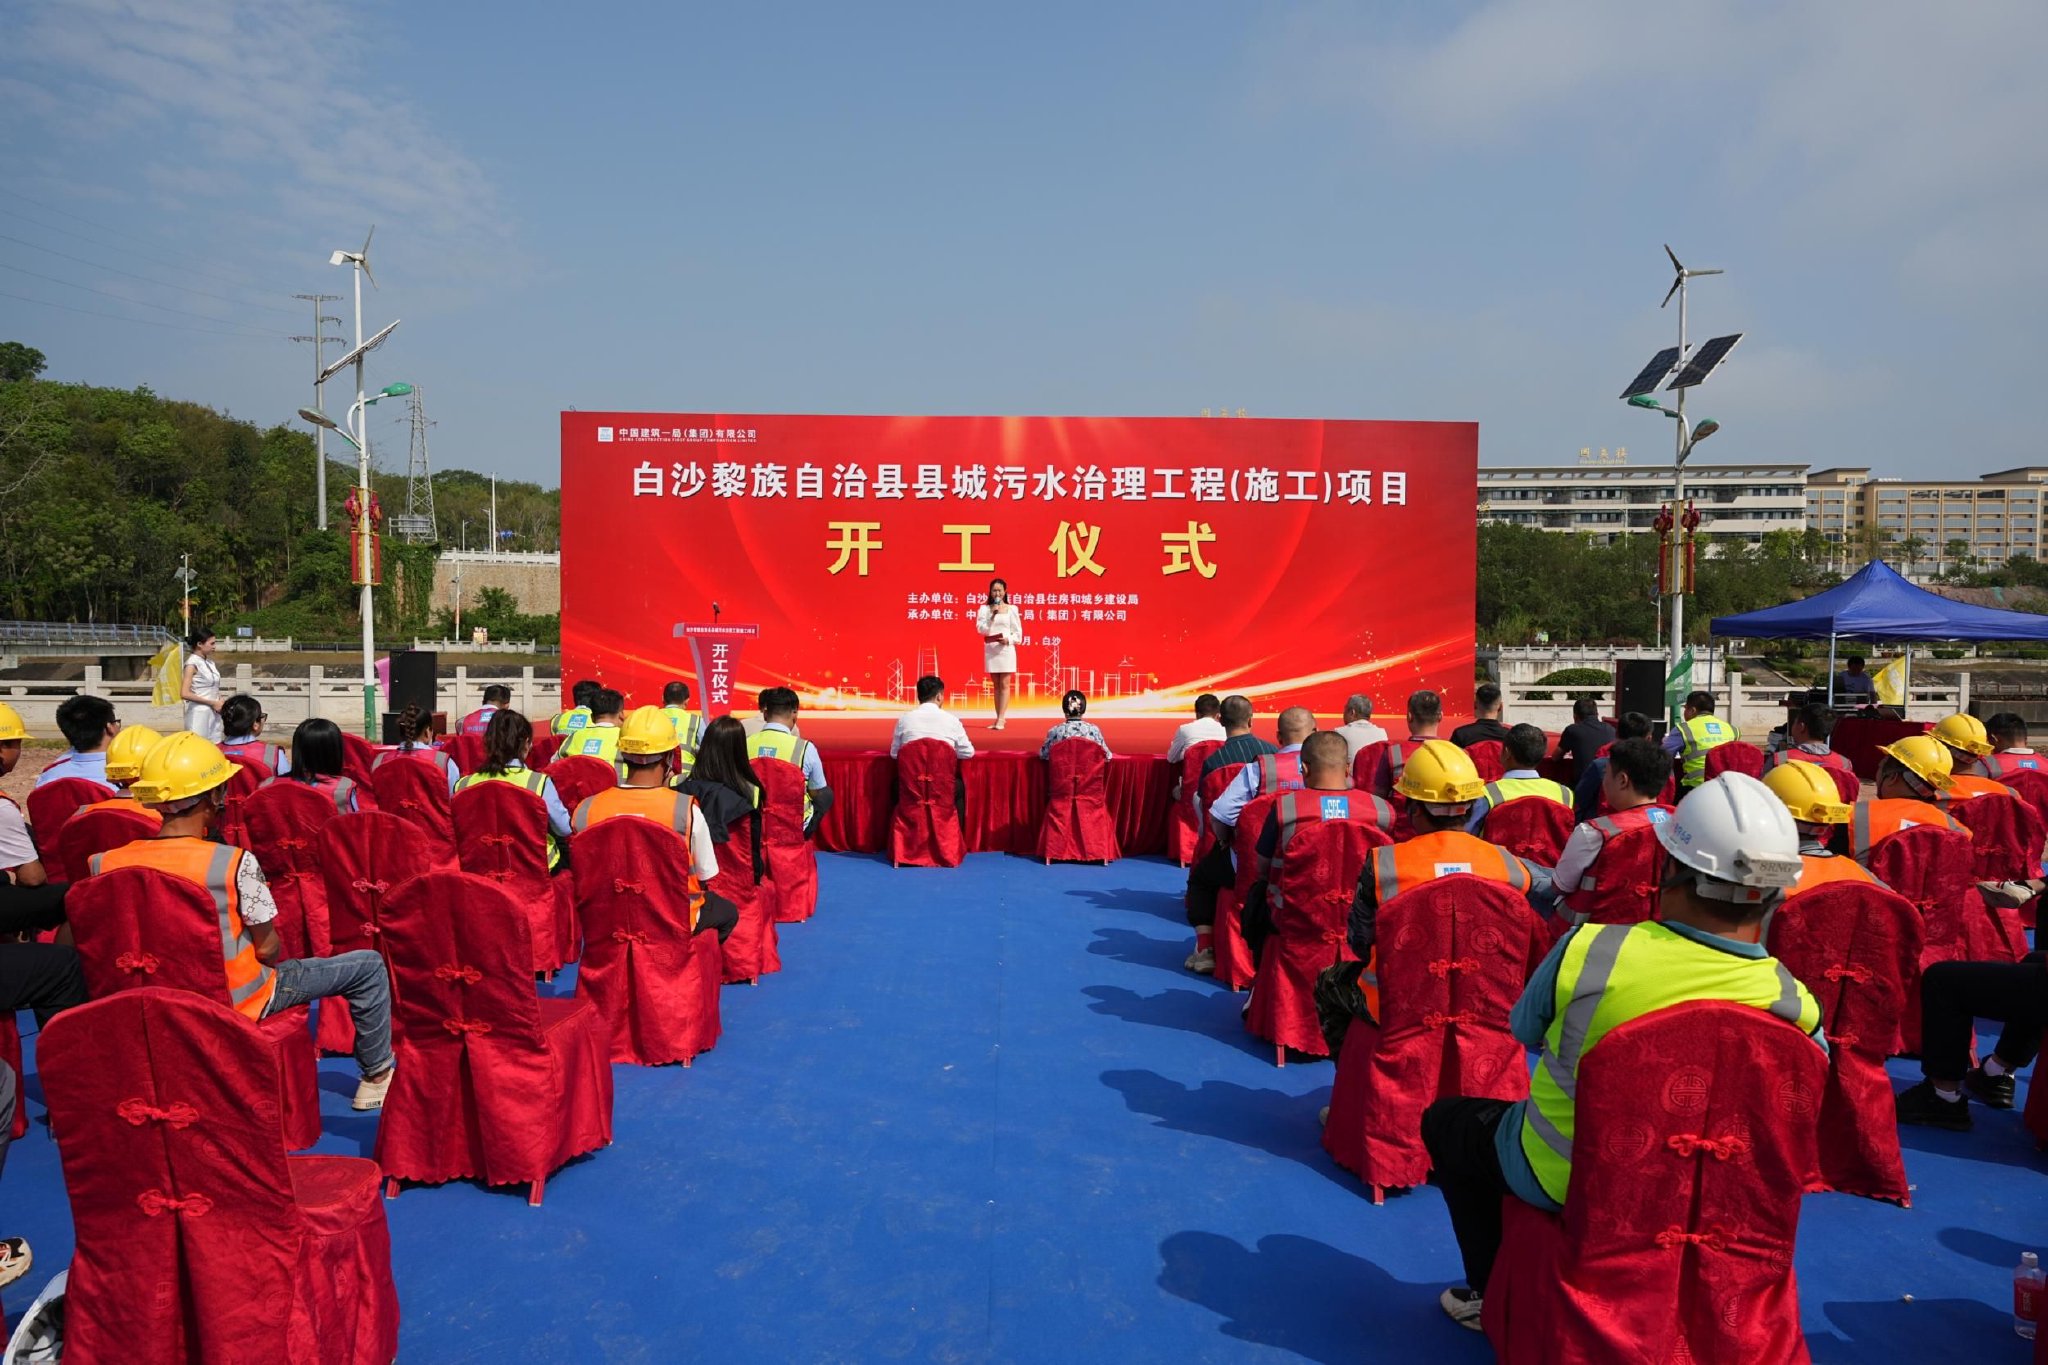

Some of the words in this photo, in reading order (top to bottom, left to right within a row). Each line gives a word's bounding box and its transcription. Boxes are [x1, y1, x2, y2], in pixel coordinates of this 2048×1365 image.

[633, 461, 1407, 506] 白沙黎族自治县县城污水治理工程(施工)项目
[826, 520, 1218, 579] 开工仪式
[907, 592, 1139, 605] 主办单位：白沙自治县住房和城乡建设局
[711, 643, 729, 705] 开工仪式
